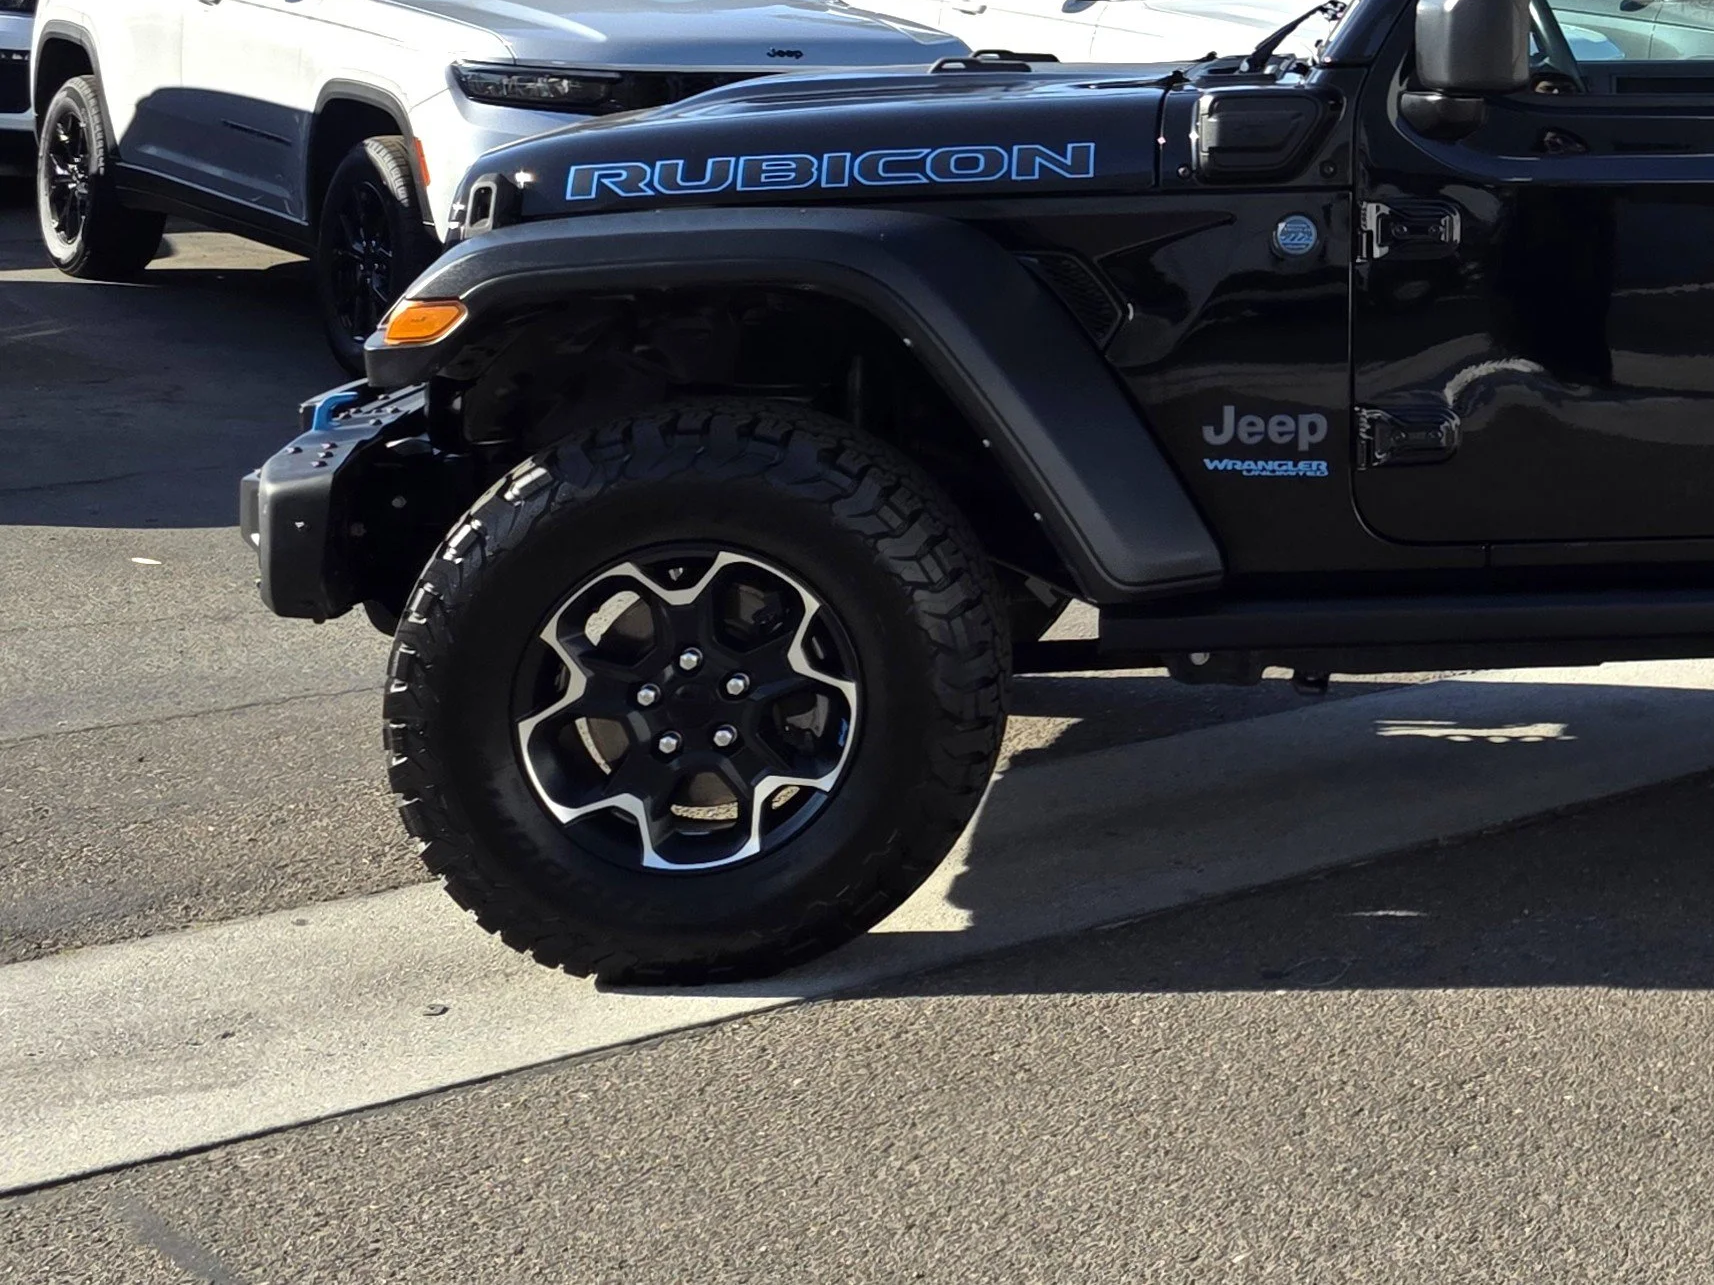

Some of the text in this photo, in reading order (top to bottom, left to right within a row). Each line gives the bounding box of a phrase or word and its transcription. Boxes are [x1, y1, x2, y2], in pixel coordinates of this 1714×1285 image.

[766, 48, 804, 60] Jeep
[565, 142, 1096, 201] RUBICON
[1201, 404, 1328, 452] Jeep
[1203, 458, 1328, 471] WRANGLER
[1242, 469, 1329, 477] UNLIMITED
